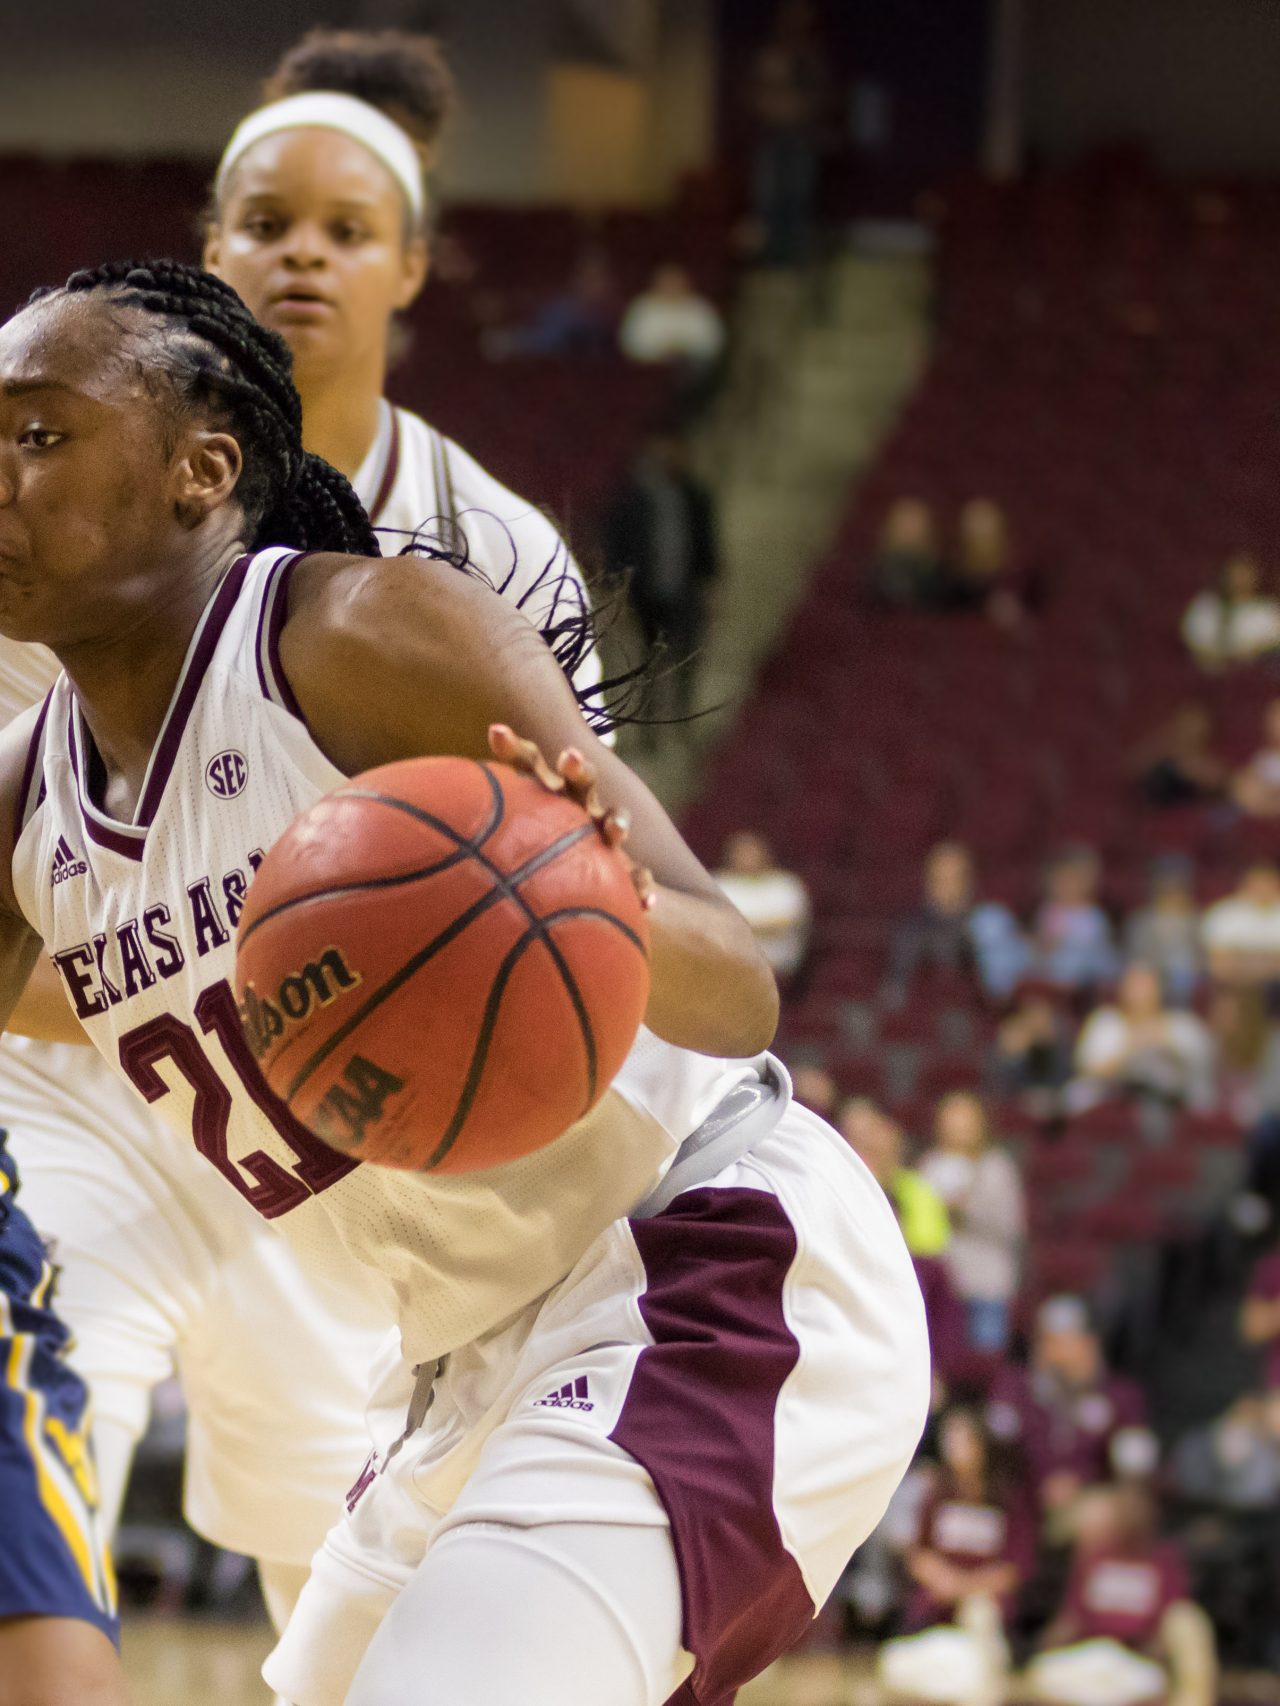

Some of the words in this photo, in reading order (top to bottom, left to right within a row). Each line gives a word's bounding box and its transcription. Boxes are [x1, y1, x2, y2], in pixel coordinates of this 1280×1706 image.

[209, 753, 246, 797] SEC
[51, 902, 186, 1020] EXAS
[187, 846, 266, 958] A&
[118, 977, 365, 1220] 21
[532, 1395, 595, 1412] adidas
